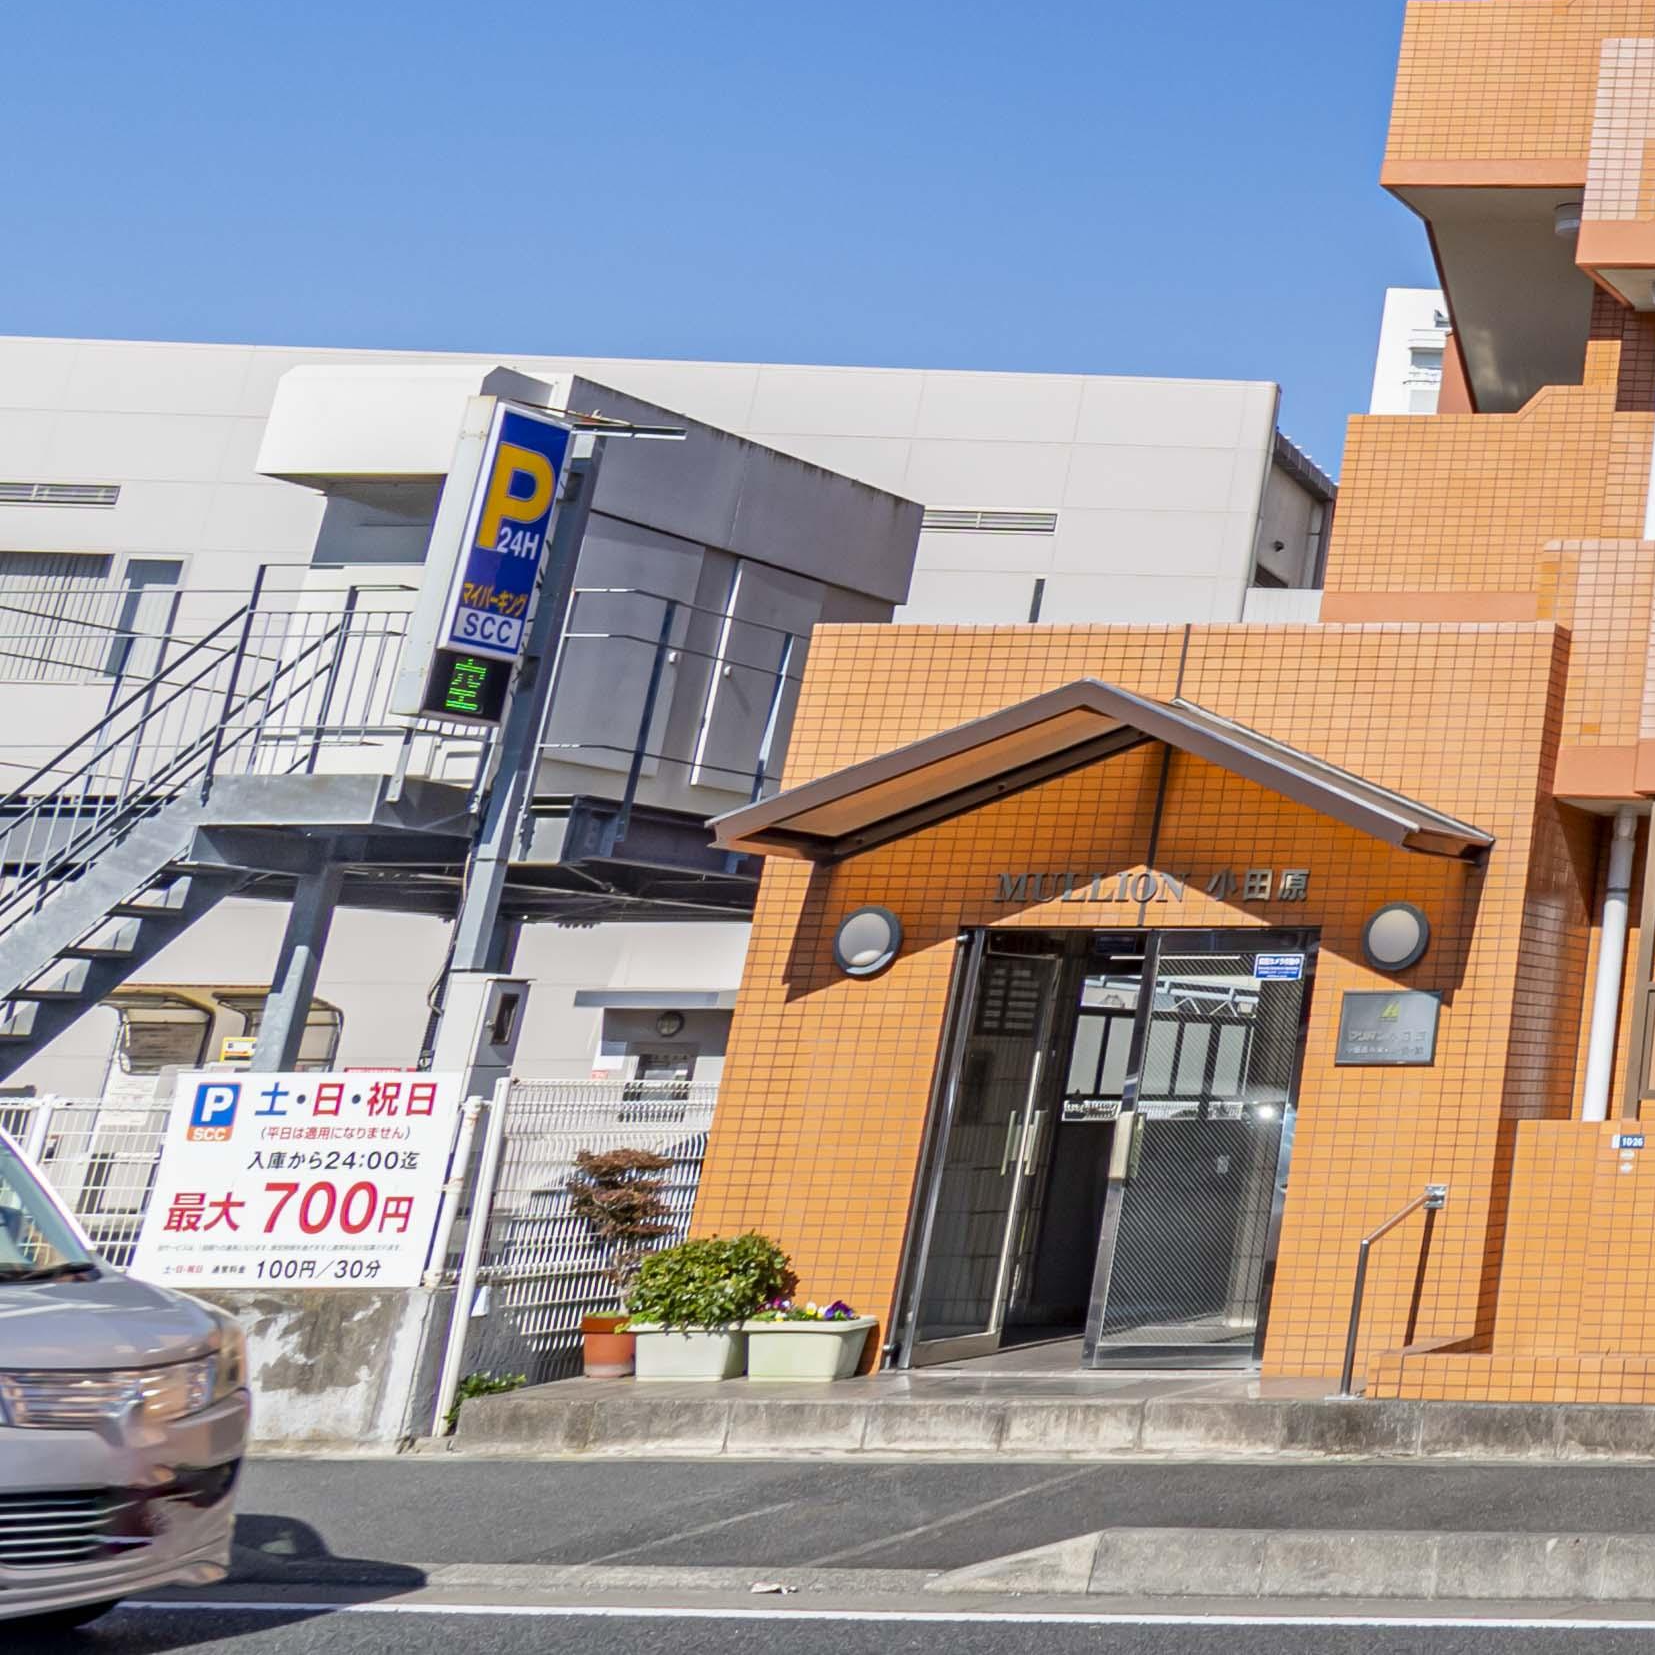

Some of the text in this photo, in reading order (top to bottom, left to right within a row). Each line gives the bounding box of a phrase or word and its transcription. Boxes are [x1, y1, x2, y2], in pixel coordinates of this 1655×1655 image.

[475, 441, 556, 551] P
[497, 526, 540, 561] 24H
[462, 582, 529, 617] マイパーキング
[463, 612, 513, 645] SCC
[993, 867, 1310, 902] MULLION 小田原
[200, 1087, 234, 1122] P
[254, 1081, 438, 1117] 土・日・祝日
[194, 1127, 226, 1141] SCC
